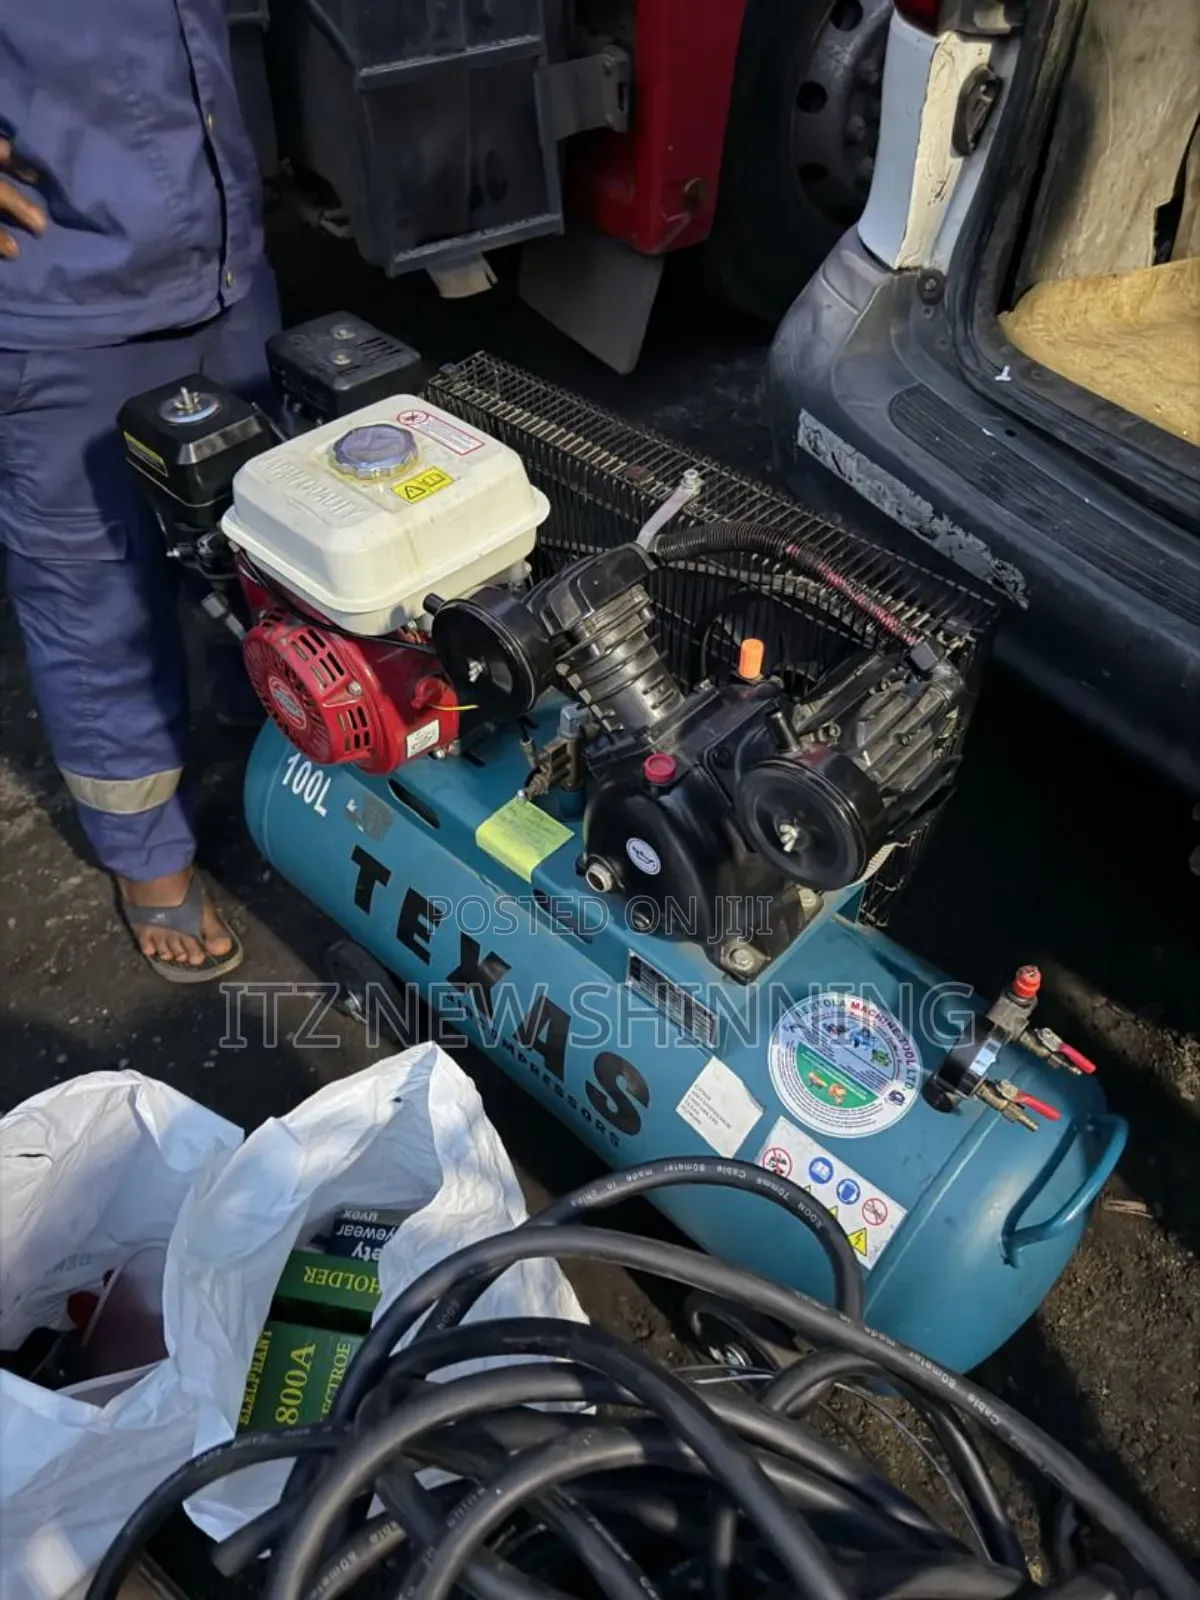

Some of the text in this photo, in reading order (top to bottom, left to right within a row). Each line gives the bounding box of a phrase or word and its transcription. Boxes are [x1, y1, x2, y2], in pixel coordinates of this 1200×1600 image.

[282, 752, 332, 818] 100L
[351, 844, 651, 1136] TEXAS
[625, 1168, 653, 1182] made
[335, 1223, 397, 1242] yewear
[351, 1240, 383, 1262] ety
[303, 1265, 382, 1296] HOLDER
[274, 1340, 317, 1426] 800A
[319, 1342, 351, 1422] ECTROE
